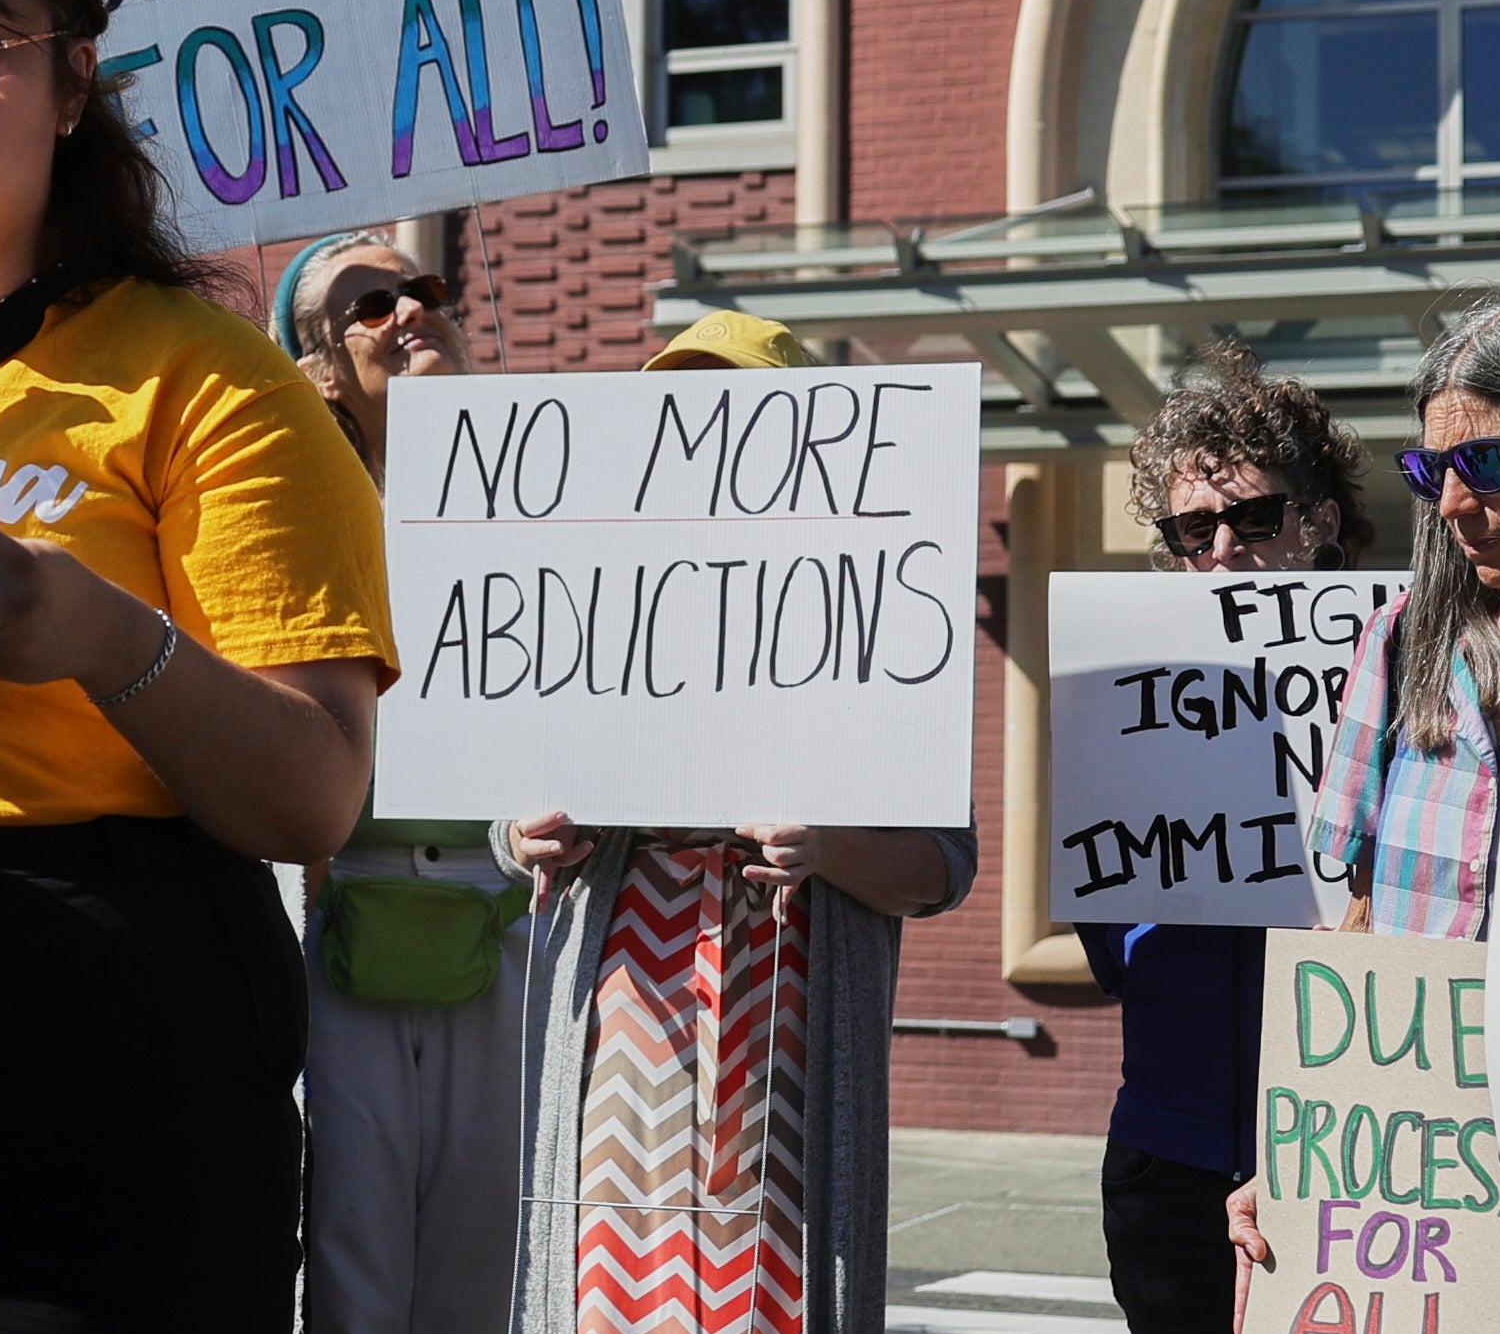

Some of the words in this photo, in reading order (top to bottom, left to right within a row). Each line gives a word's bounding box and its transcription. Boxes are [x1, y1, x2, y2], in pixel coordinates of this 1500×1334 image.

[437, 398, 571, 520] NO
[634, 383, 934, 518] MORE
[420, 539, 955, 701] ABDUCTIONS
[1211, 581, 1403, 648] FIG
[1295, 959, 1489, 1089] DUE
[1317, 1199, 1458, 1284] FOR
